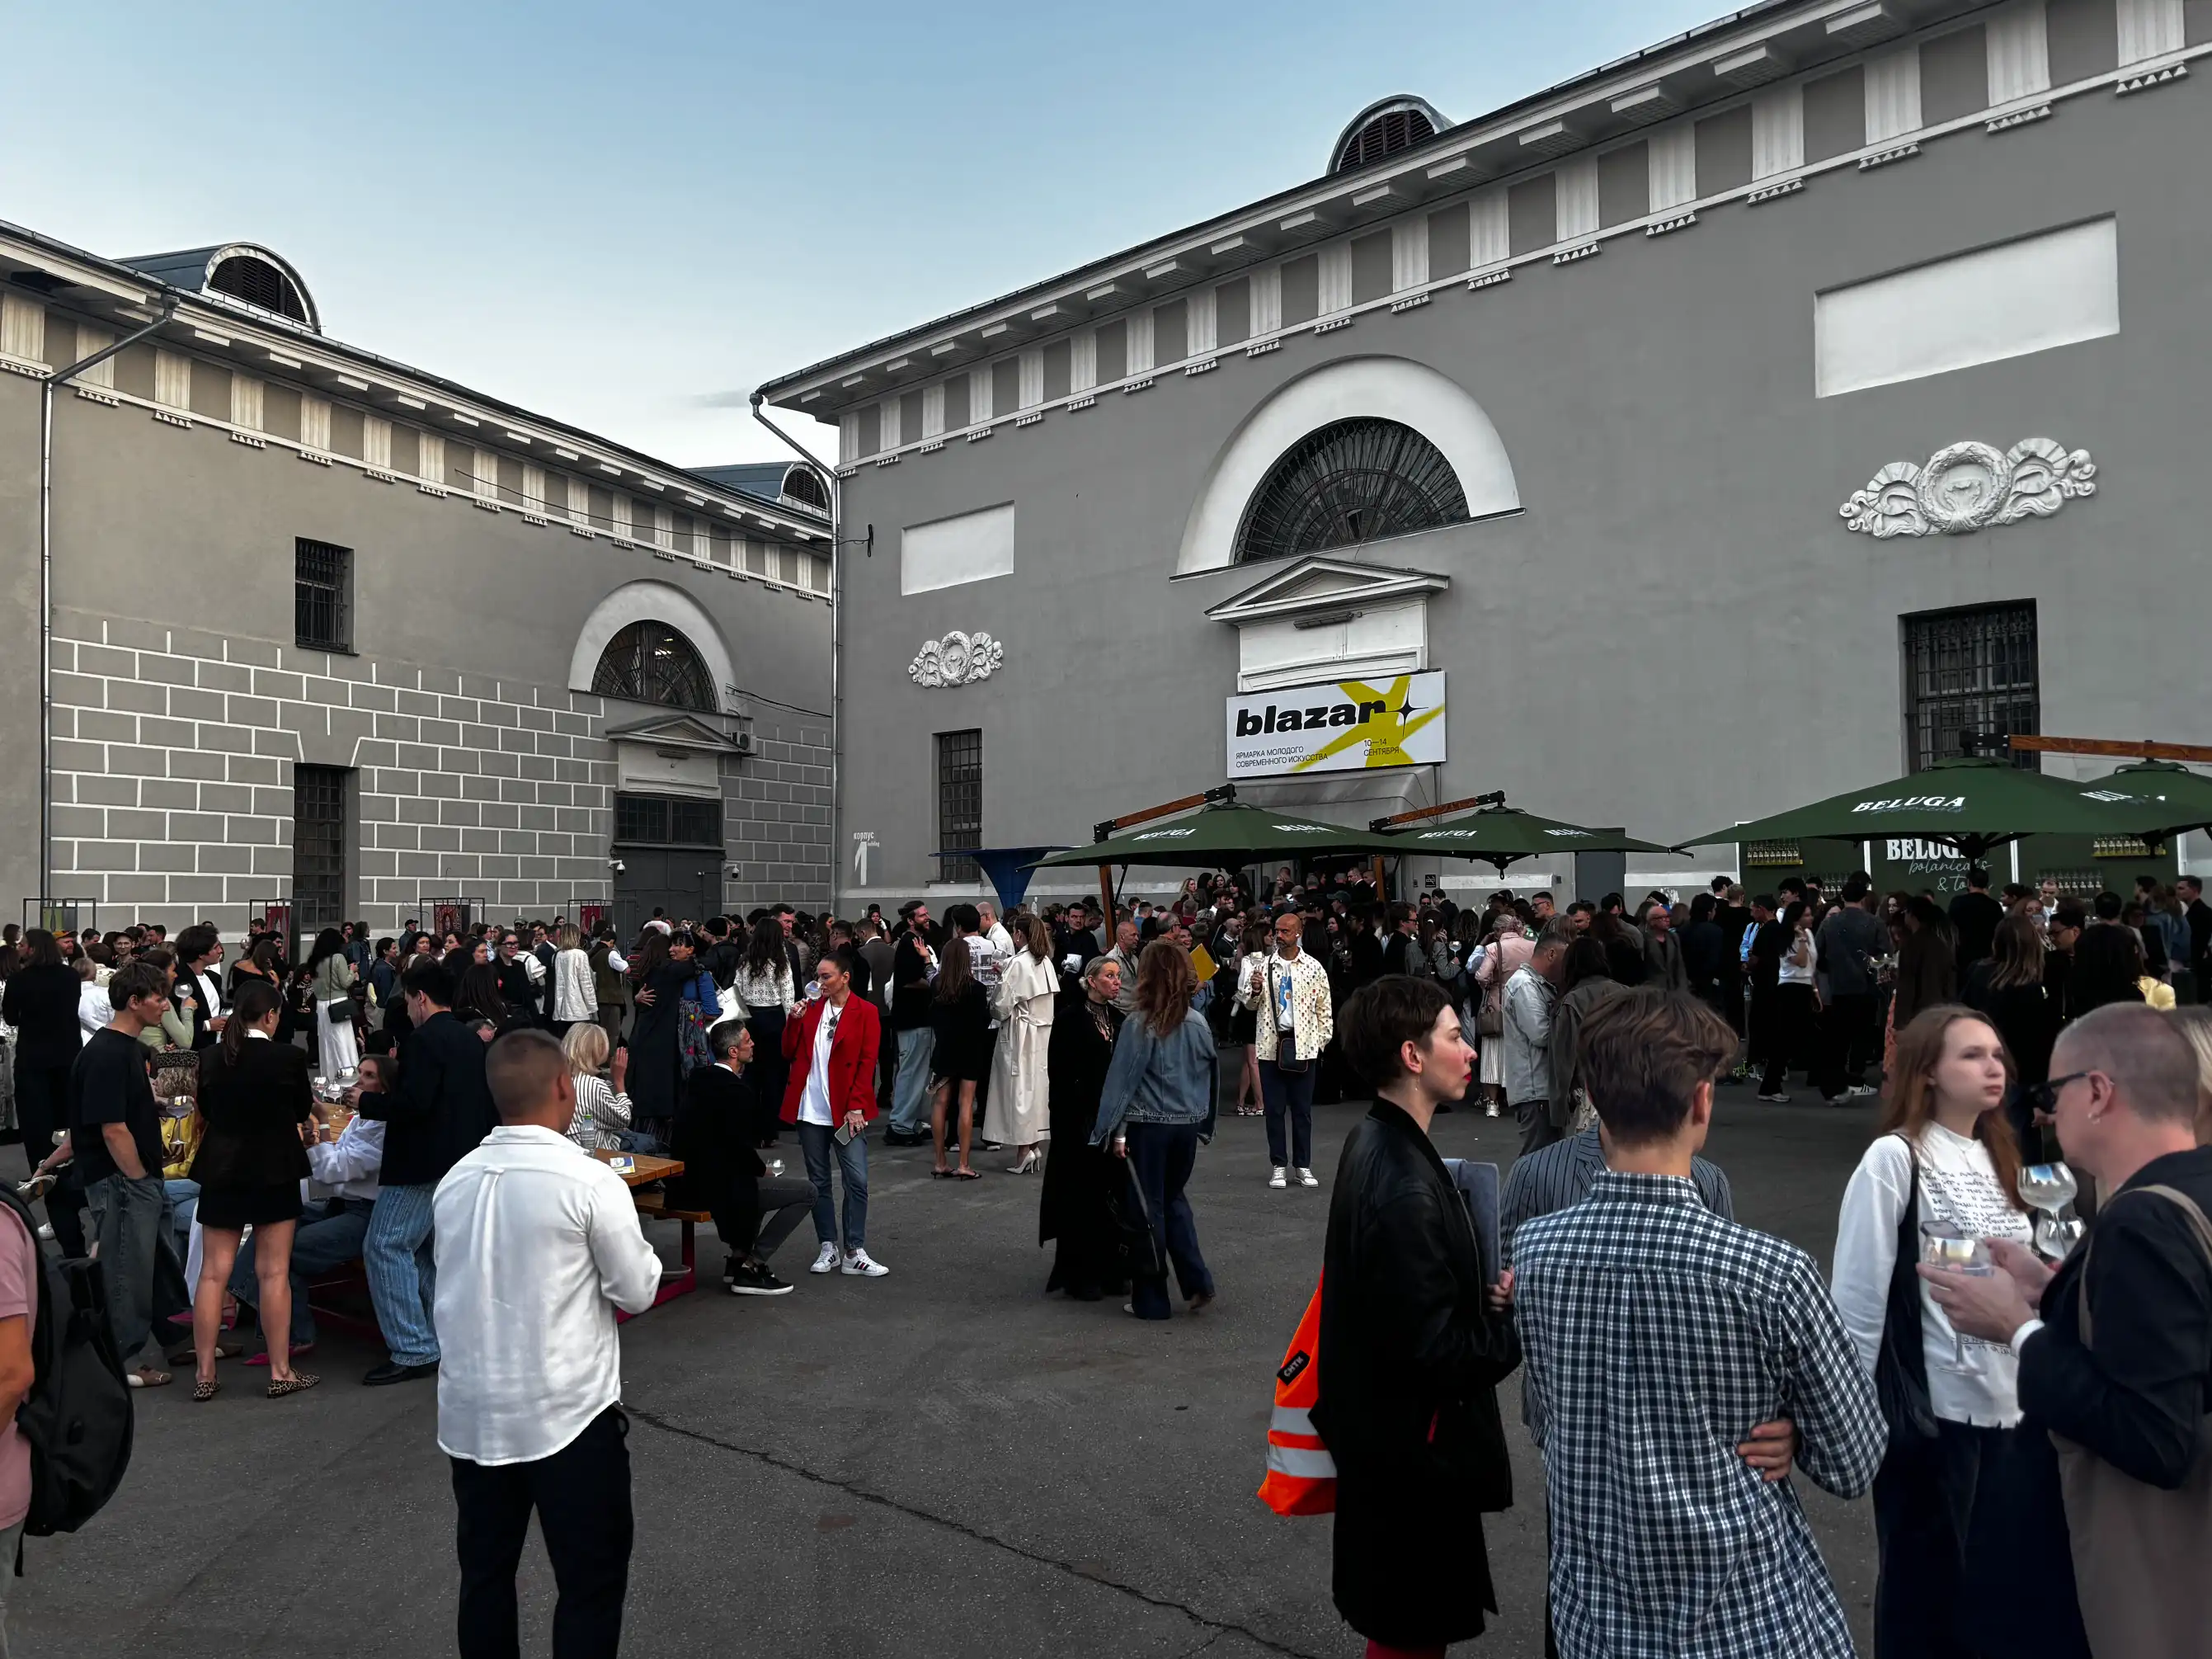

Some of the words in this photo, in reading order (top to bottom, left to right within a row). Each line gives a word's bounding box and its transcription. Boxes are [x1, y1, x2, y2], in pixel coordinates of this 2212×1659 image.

[1235, 700, 1387, 738] blazar
[1235, 750, 1266, 760] ЯРМАРКА
[1266, 746, 1304, 756] МОЛОДОГО
[1363, 746, 1400, 756] СЕНТЯБРЯ
[1235, 756, 1287, 768] СОВРЕМЕННОГО
[1288, 752, 1328, 763] ИСКУССТВА
[1850, 796, 1966, 813] BELUGA
[853, 832, 874, 841] корпус
[1885, 837, 1967, 860] BELUG
[854, 841, 868, 886] 1
